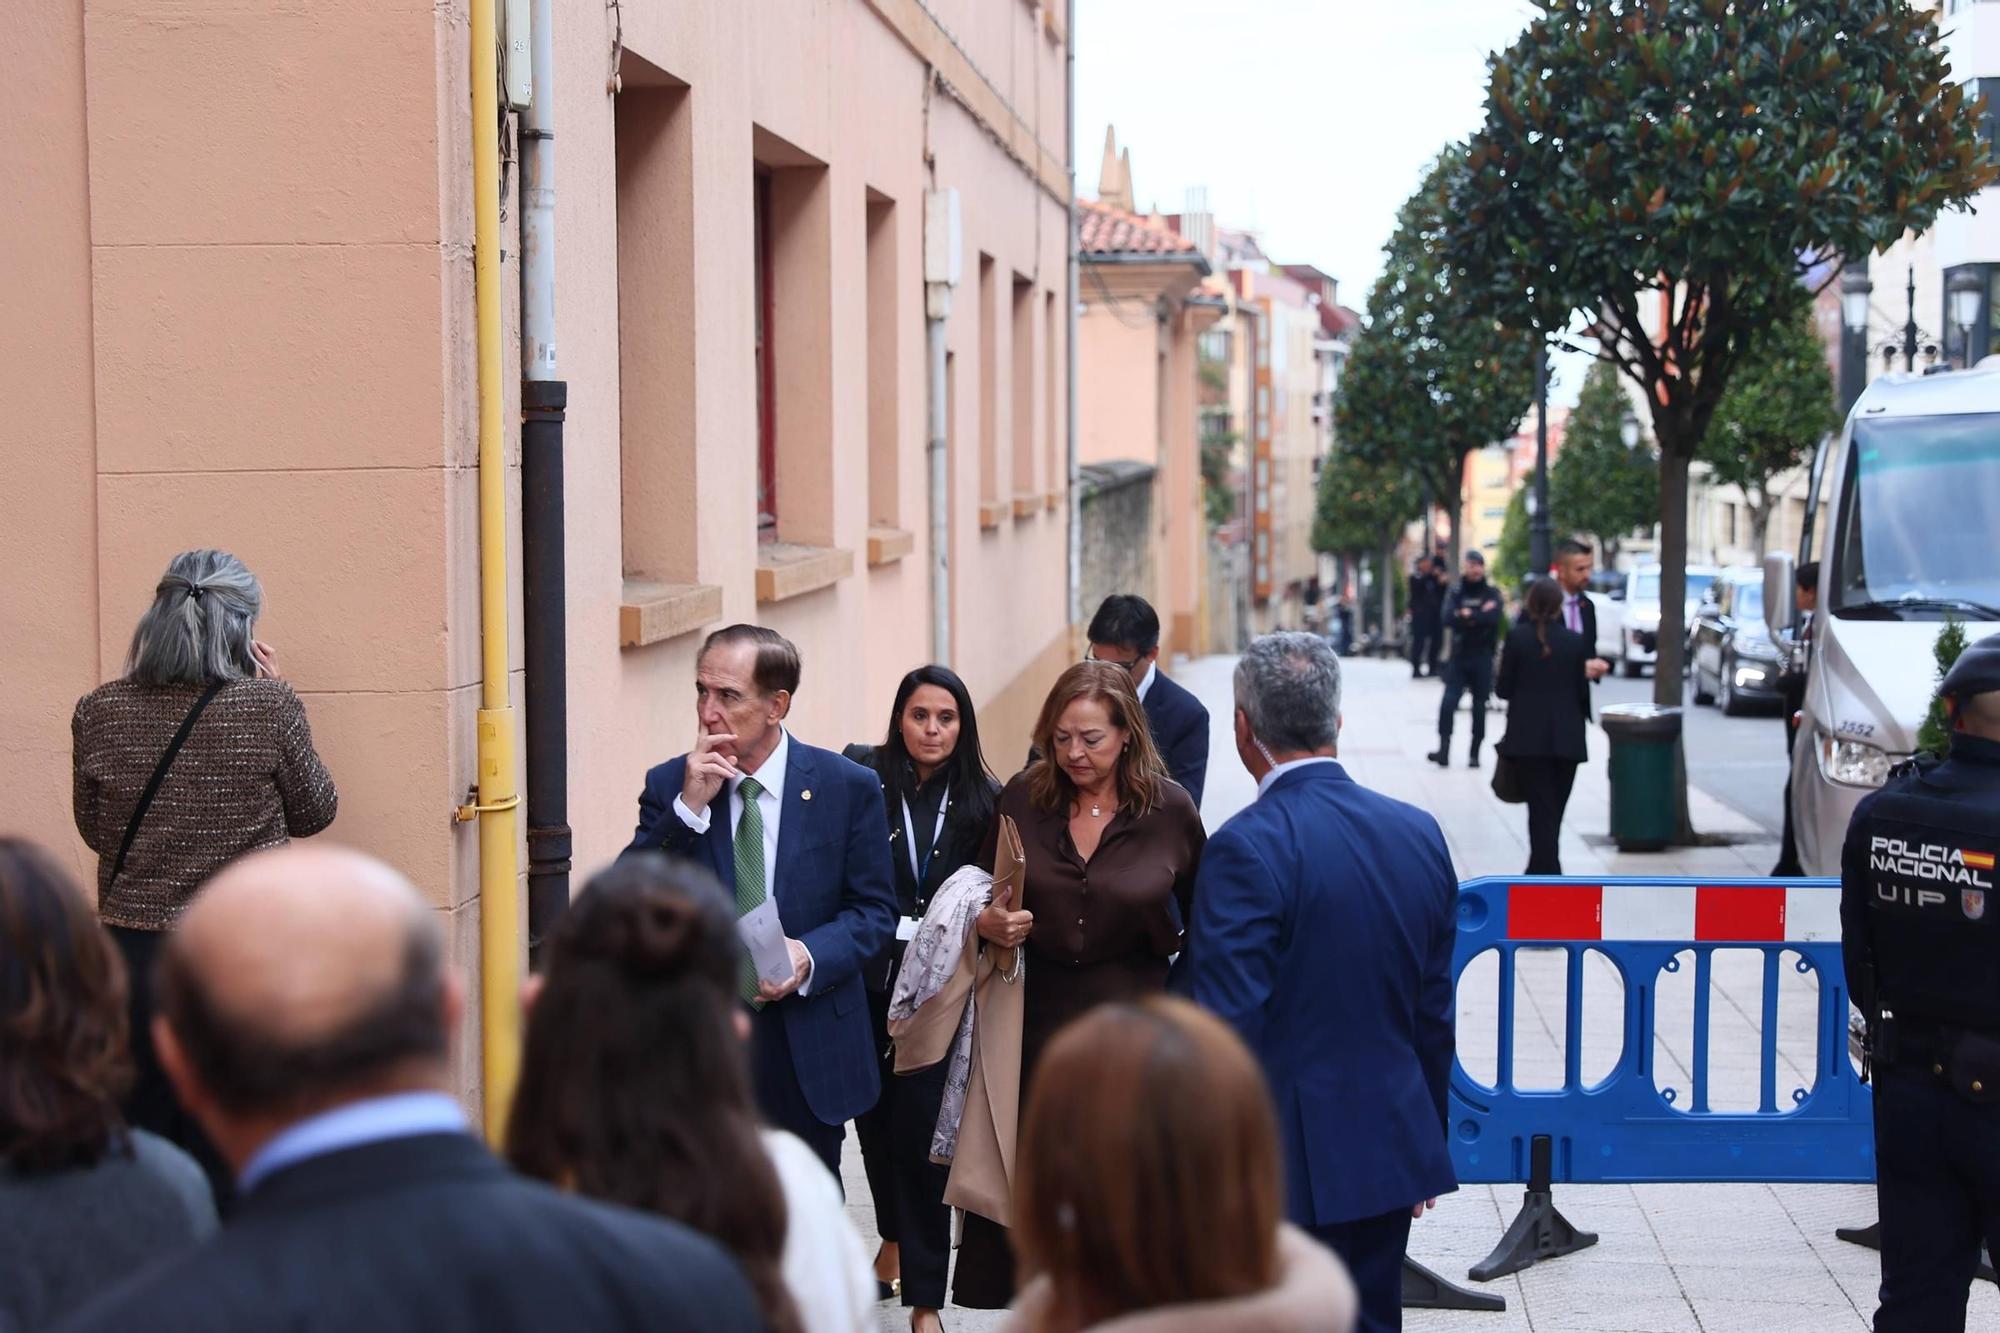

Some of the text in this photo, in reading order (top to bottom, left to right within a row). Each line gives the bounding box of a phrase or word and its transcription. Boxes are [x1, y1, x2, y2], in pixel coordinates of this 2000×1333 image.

[1871, 836, 1965, 866] POLICIA
[1870, 853, 1993, 889] NACIONAL
[1878, 882, 1946, 907] UIP
